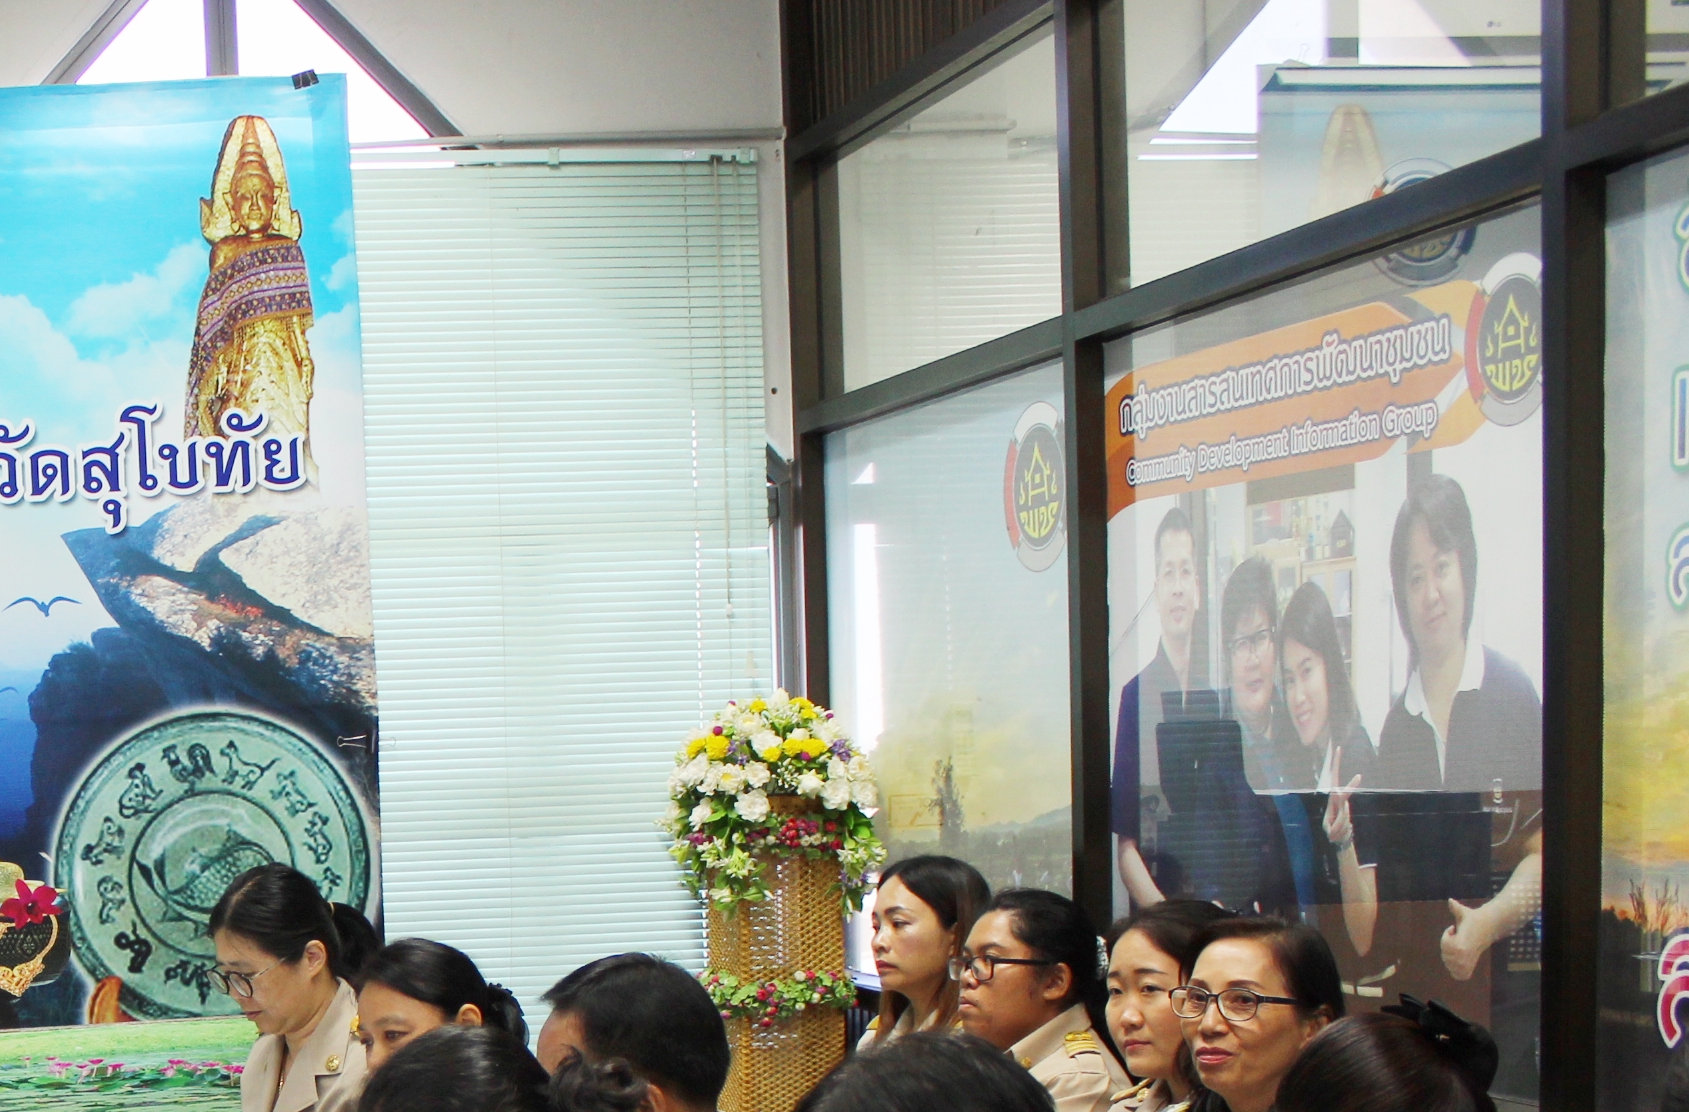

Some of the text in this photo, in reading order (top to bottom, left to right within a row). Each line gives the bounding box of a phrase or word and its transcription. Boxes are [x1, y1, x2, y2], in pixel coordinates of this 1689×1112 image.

[1119, 317, 1452, 440] กลุ่มงานสารสนเทศการพัฒนาชุมชน
[1125, 400, 1438, 486] Community Development Information Group
